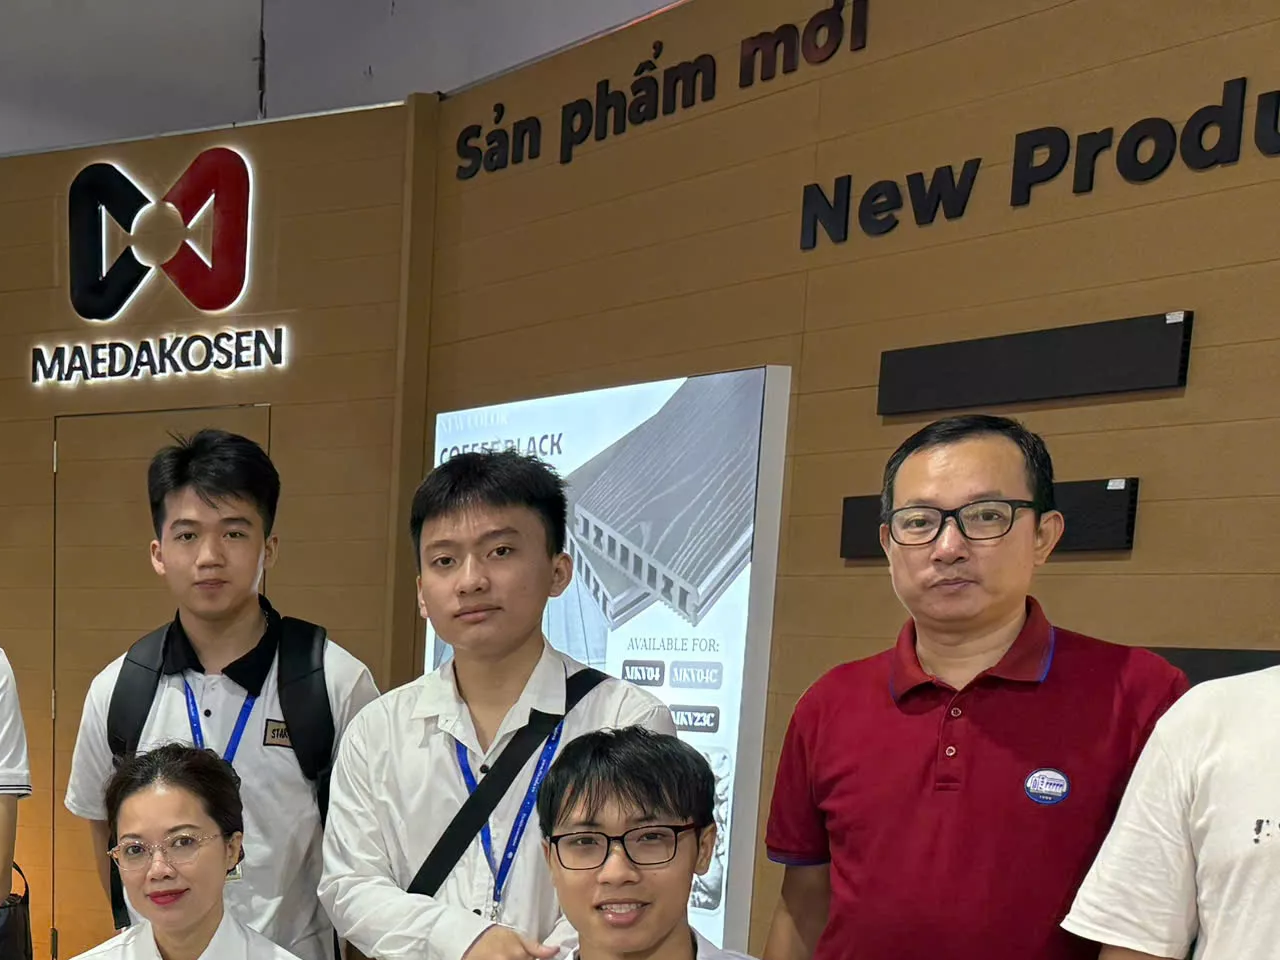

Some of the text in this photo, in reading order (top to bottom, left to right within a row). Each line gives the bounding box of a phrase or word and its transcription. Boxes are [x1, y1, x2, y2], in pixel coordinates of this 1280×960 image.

[456, 104, 540, 180] Sản
[559, 40, 716, 164] phẩm
[799, 158, 981, 250] New
[32, 328, 283, 383] MAEDAKOSEN
[627, 637, 720, 652] AVAILABLE FOR:
